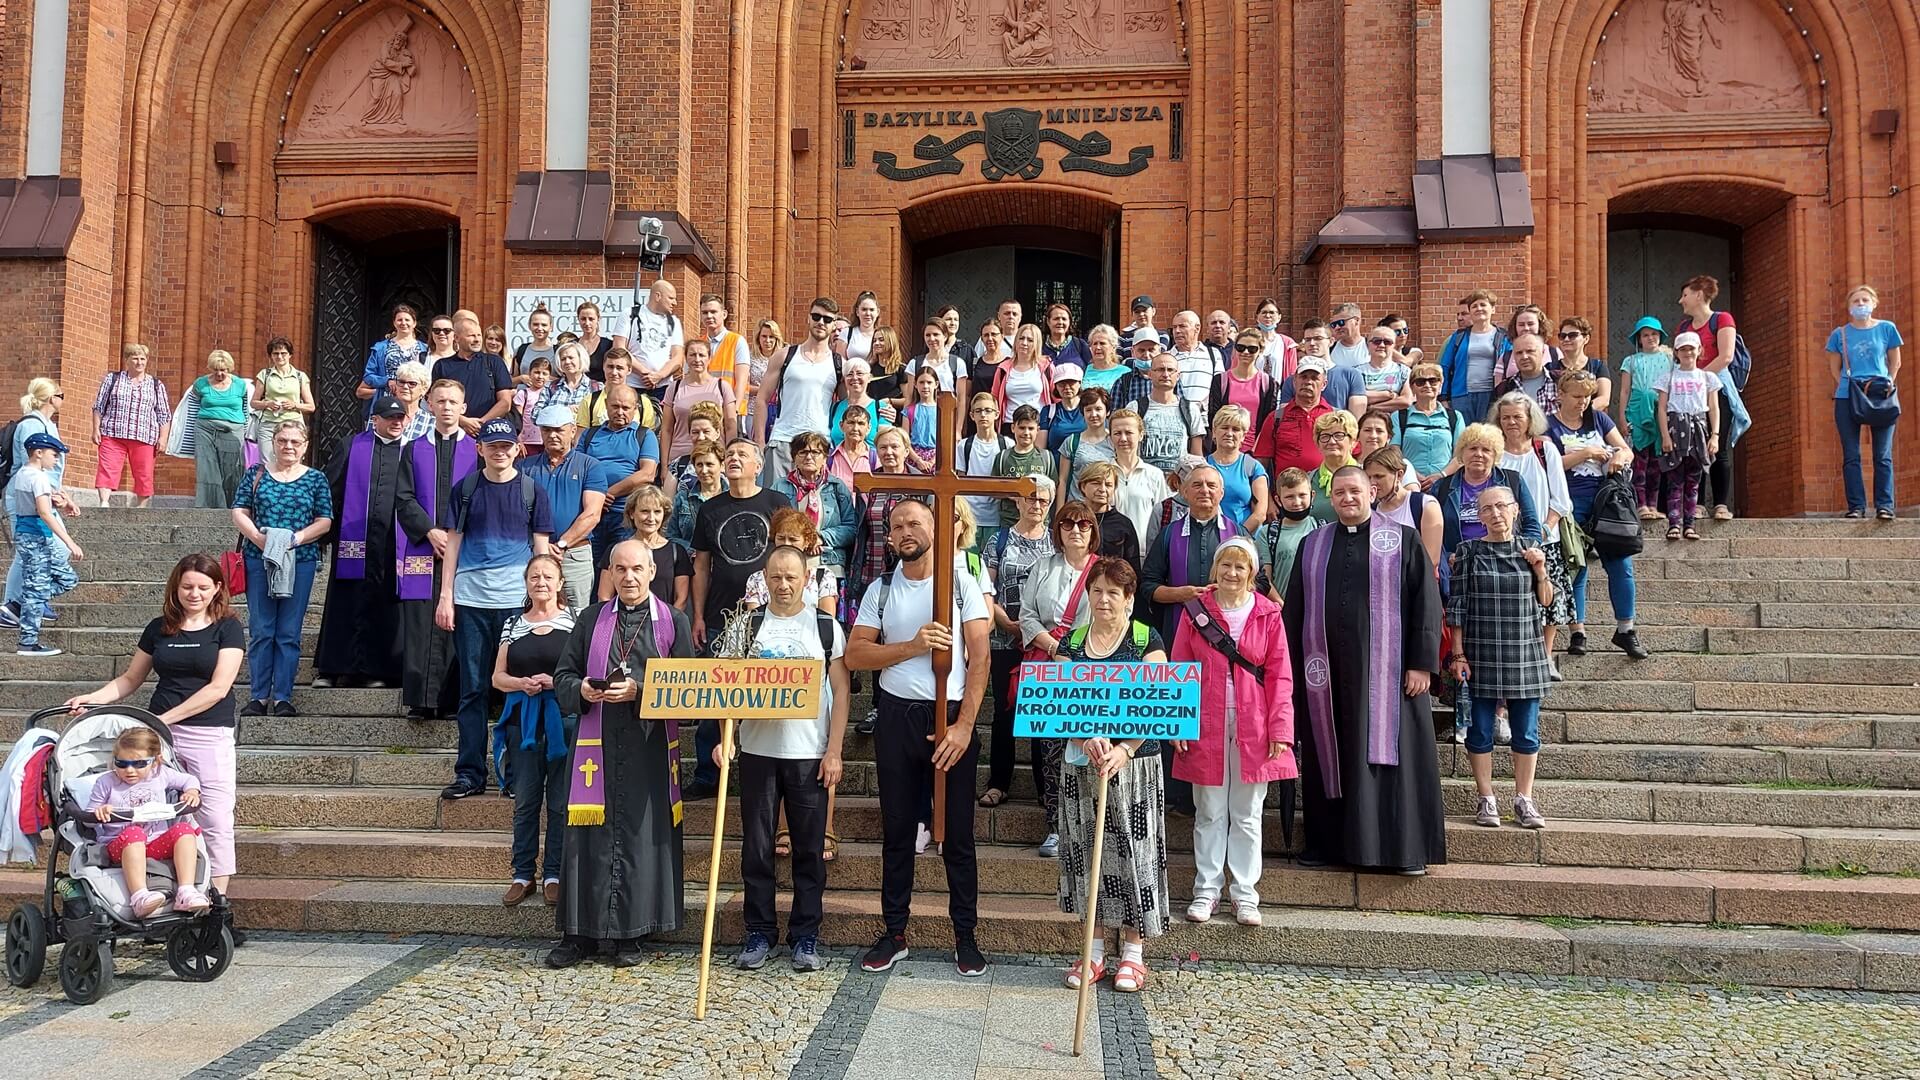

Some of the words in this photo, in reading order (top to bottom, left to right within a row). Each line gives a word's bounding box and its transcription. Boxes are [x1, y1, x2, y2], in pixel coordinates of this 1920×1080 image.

[863, 110, 978, 128] BAZYLIKA
[1046, 106, 1164, 124] MNIEJSZA
[1674, 381, 1703, 393] HEY
[652, 670, 708, 685] PARAFIA
[743, 664, 814, 685] TRÓJCY
[1020, 664, 1201, 683] PIELGRZYMKA
[650, 687, 808, 709] JUCHNOWIEC
[1022, 687, 1048, 699] DO
[1052, 687, 1111, 700] MATKI
[1119, 684, 1182, 700] BOŻEJ
[1016, 700, 1121, 717] KRÓLOWEJ
[1126, 705, 1197, 718] RODZIN
[1030, 721, 1047, 733] W
[1055, 721, 1180, 736] JUCHNOWCU
